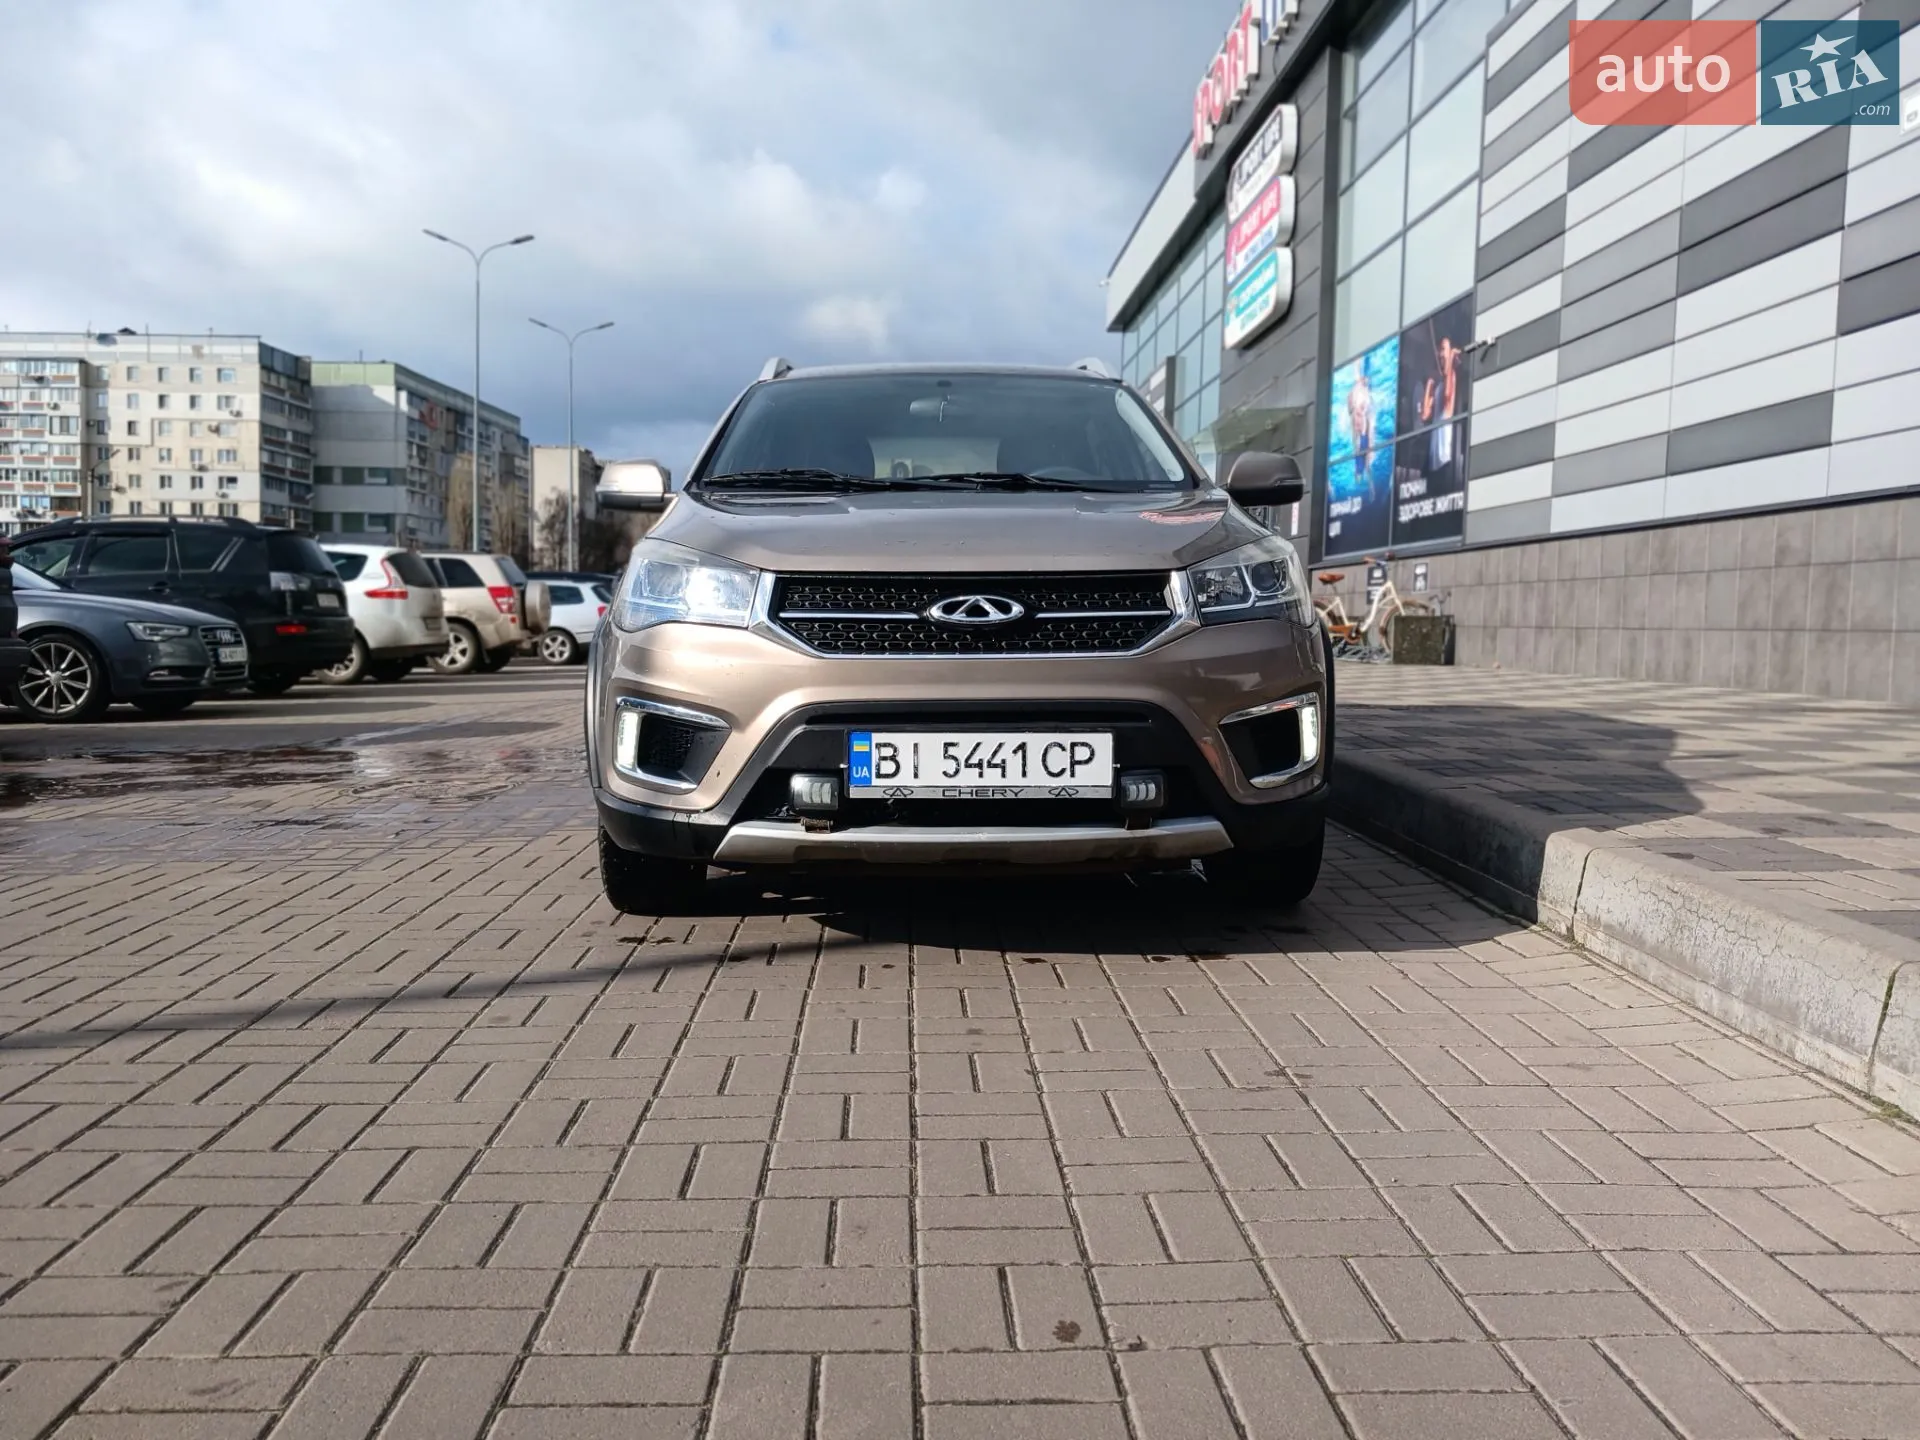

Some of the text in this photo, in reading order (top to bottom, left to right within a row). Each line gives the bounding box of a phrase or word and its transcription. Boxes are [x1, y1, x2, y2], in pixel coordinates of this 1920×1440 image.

[875, 741, 1096, 779] BI 5441 CP
[853, 767, 870, 778] UA
[942, 788, 1025, 798] CHERY
